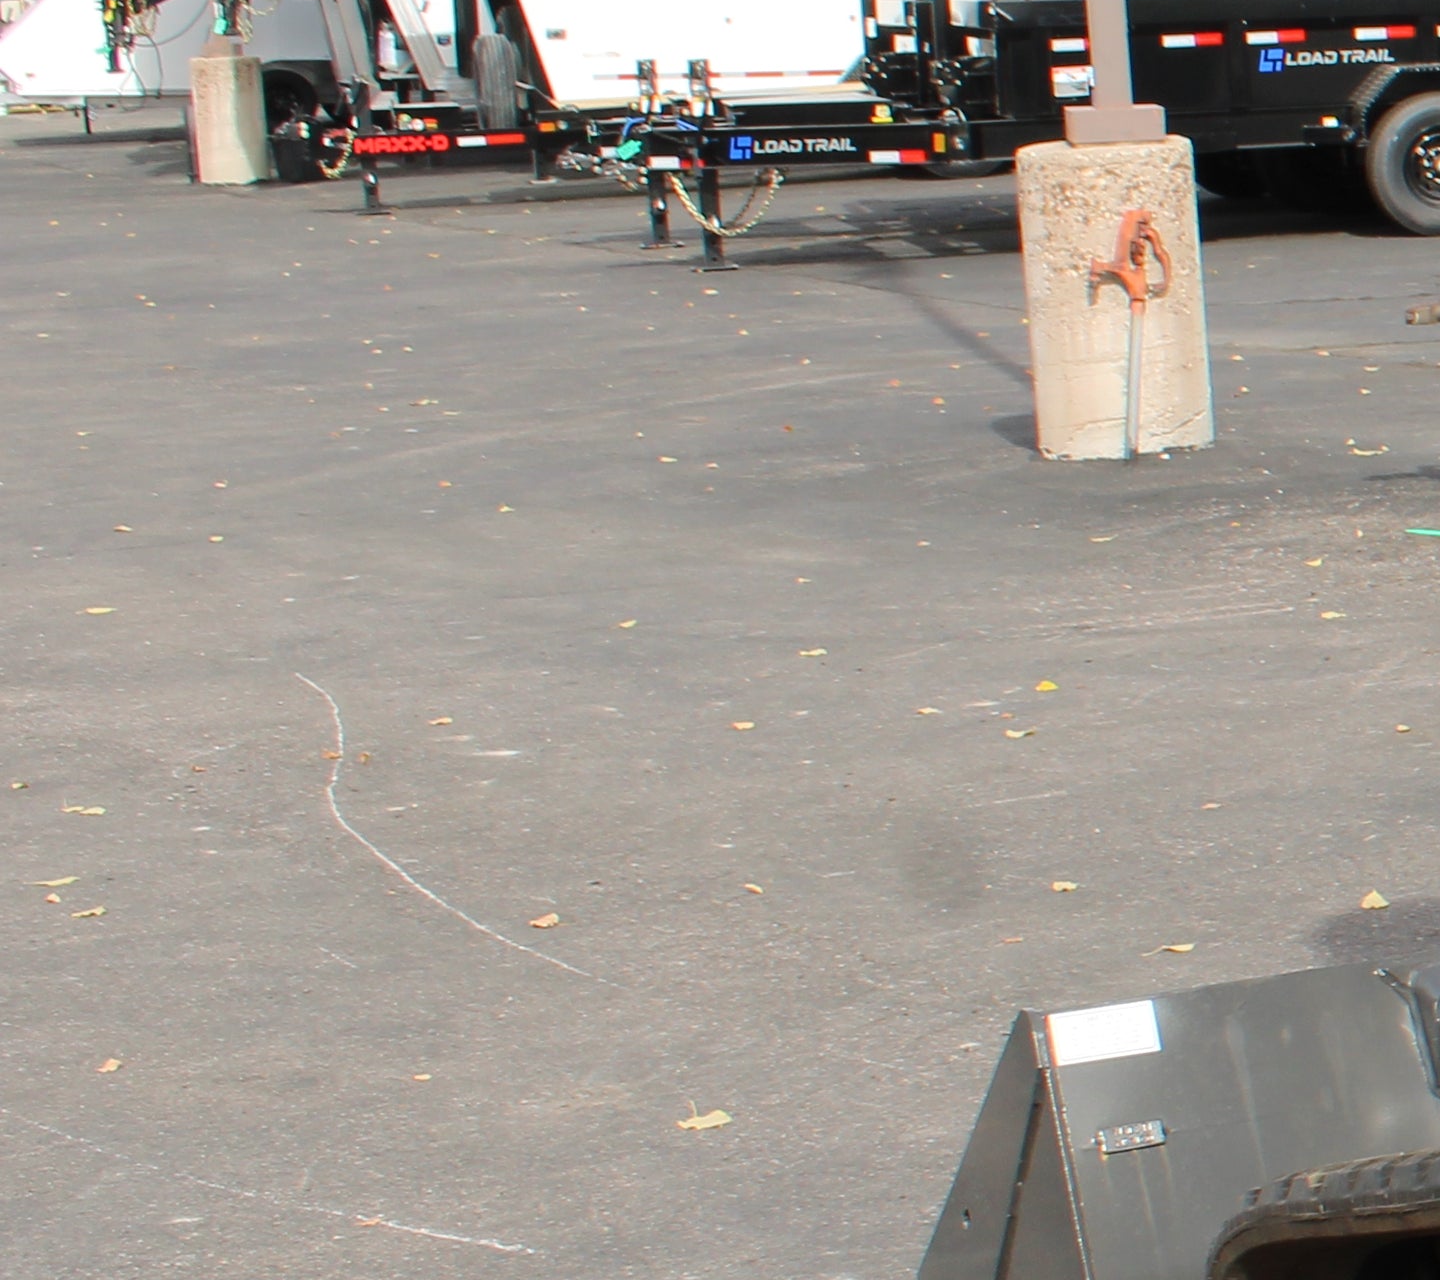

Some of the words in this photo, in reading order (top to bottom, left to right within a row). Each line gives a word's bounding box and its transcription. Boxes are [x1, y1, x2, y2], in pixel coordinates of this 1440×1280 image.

[1285, 50, 1338, 66] LOAD
[1339, 48, 1395, 63] TRAIL
[353, 134, 449, 154] MAXX-D
[753, 139, 803, 154] LOAD
[803, 137, 857, 152] TRAIL
